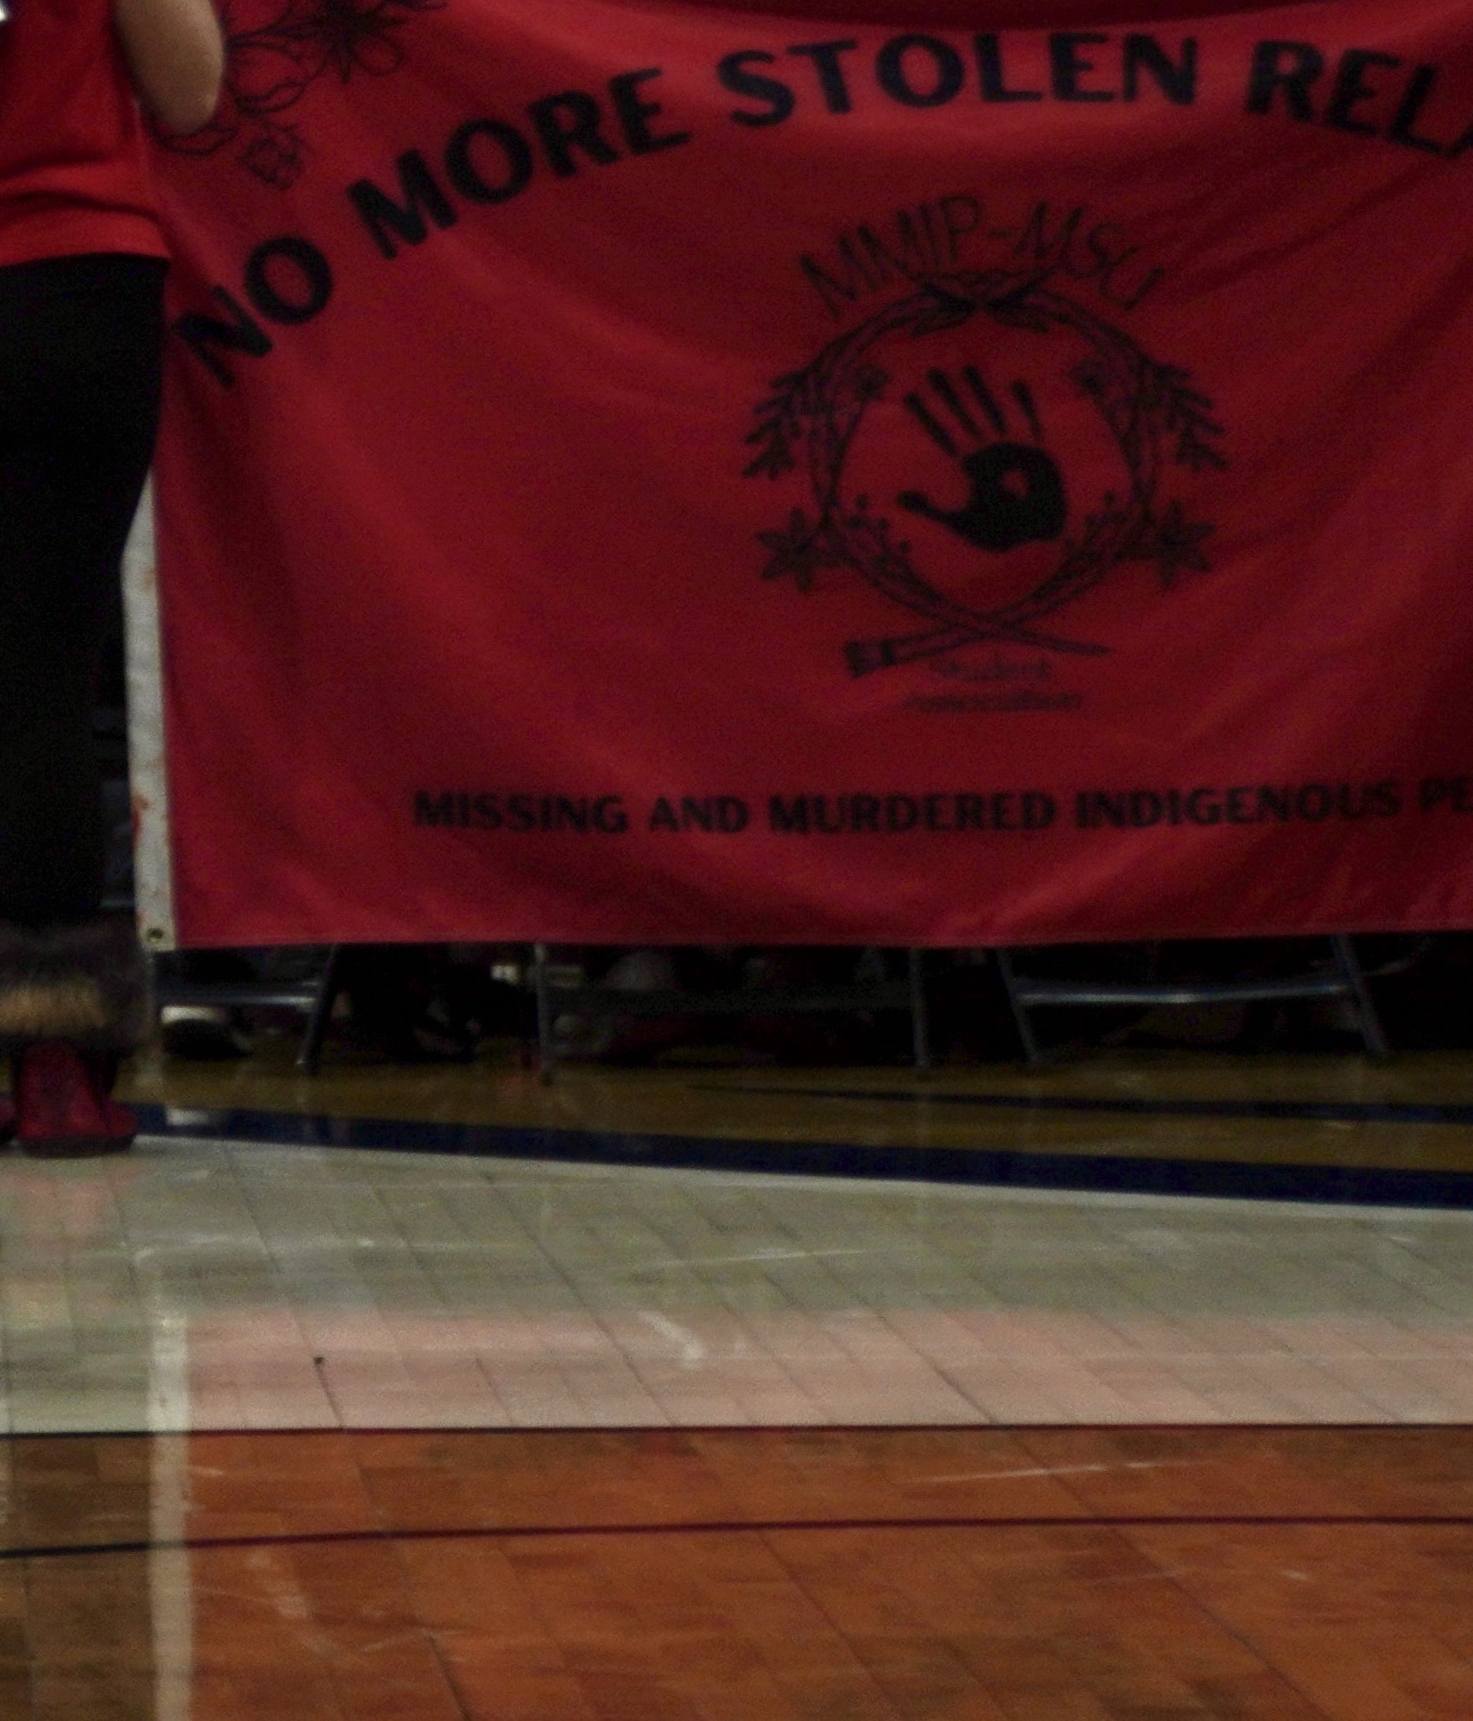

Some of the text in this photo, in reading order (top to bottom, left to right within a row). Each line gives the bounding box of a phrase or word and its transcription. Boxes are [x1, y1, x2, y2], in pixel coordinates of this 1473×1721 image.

[176, 32, 1473, 388] NO MORE STOLEN REL
[413, 789, 629, 835] MISSING
[650, 794, 750, 834] AND
[767, 789, 1057, 835] MURDERED
[1077, 780, 1400, 829] INDIGENOUS
